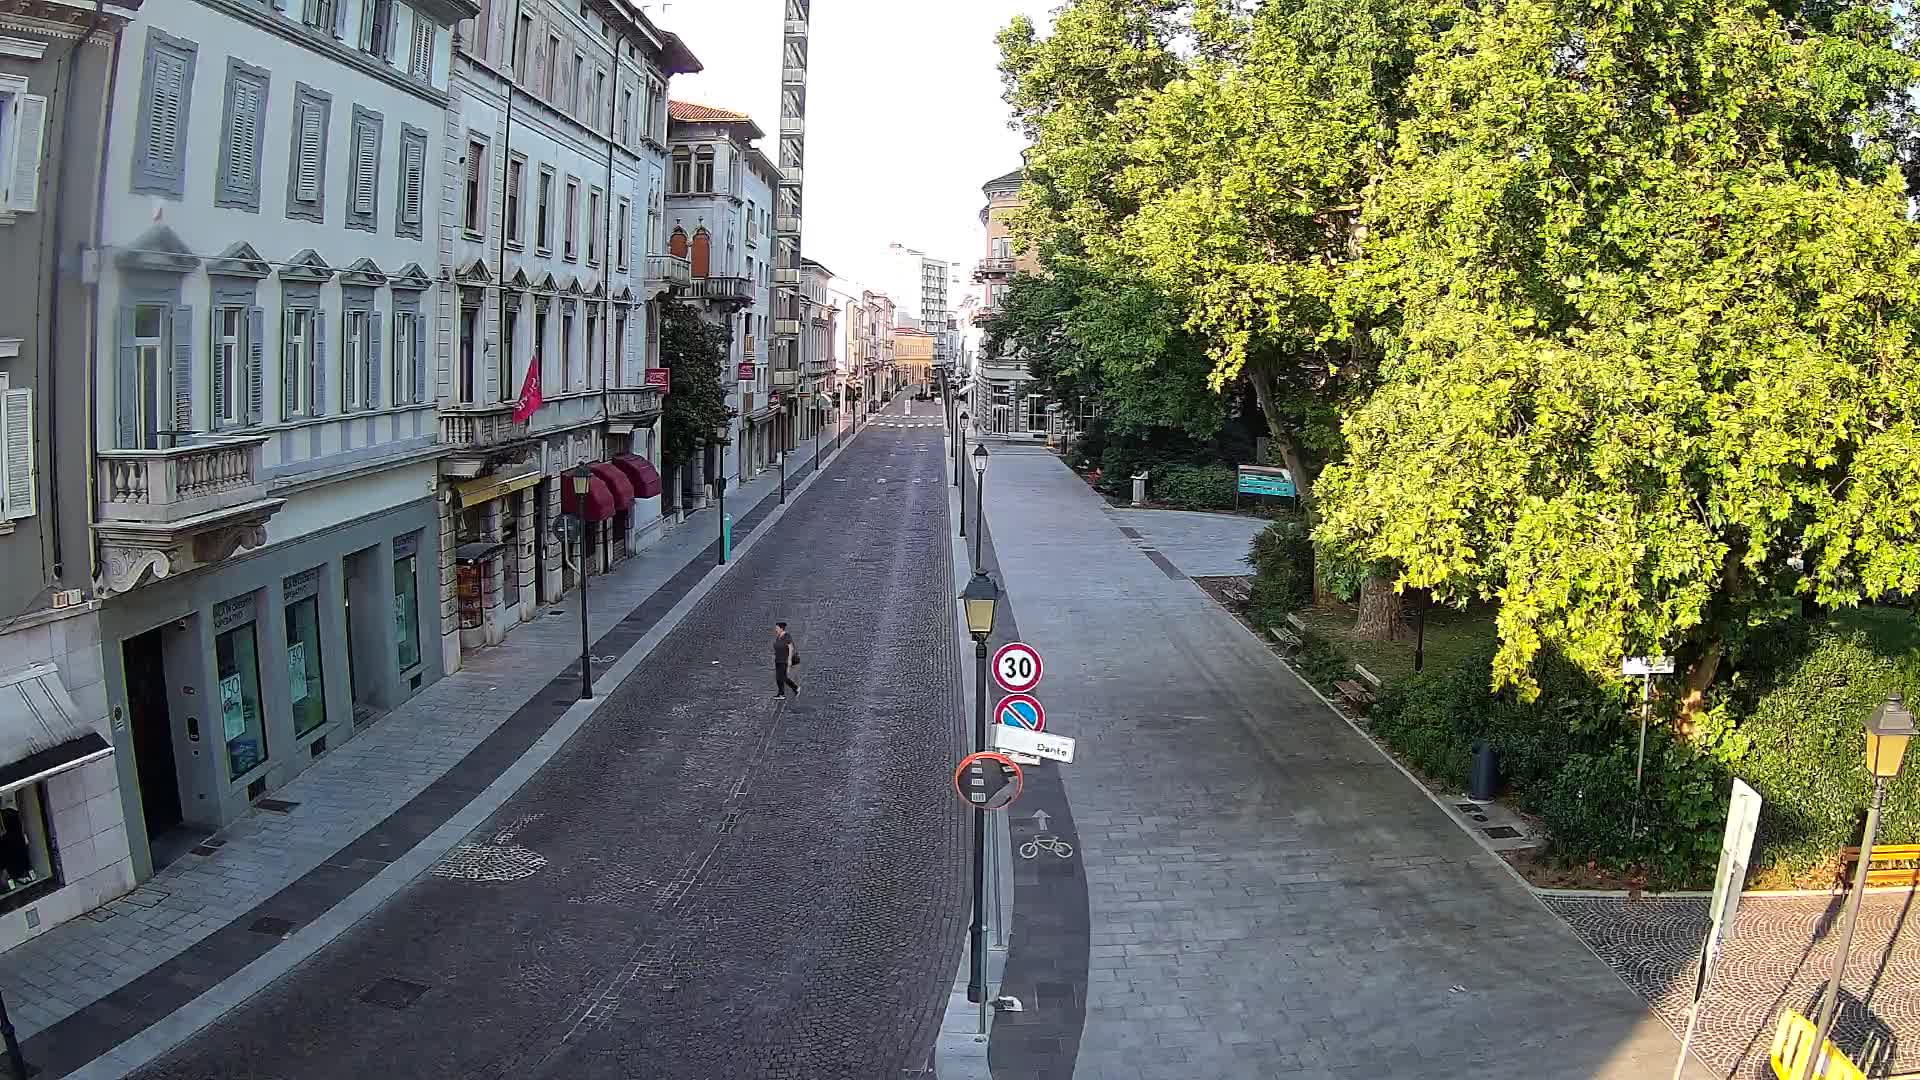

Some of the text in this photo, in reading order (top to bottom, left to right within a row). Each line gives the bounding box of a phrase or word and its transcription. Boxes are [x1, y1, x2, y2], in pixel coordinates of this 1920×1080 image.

[1005, 657, 1031, 678] 30
[221, 678, 240, 699] 130
[1036, 743, 1067, 756] Dante
